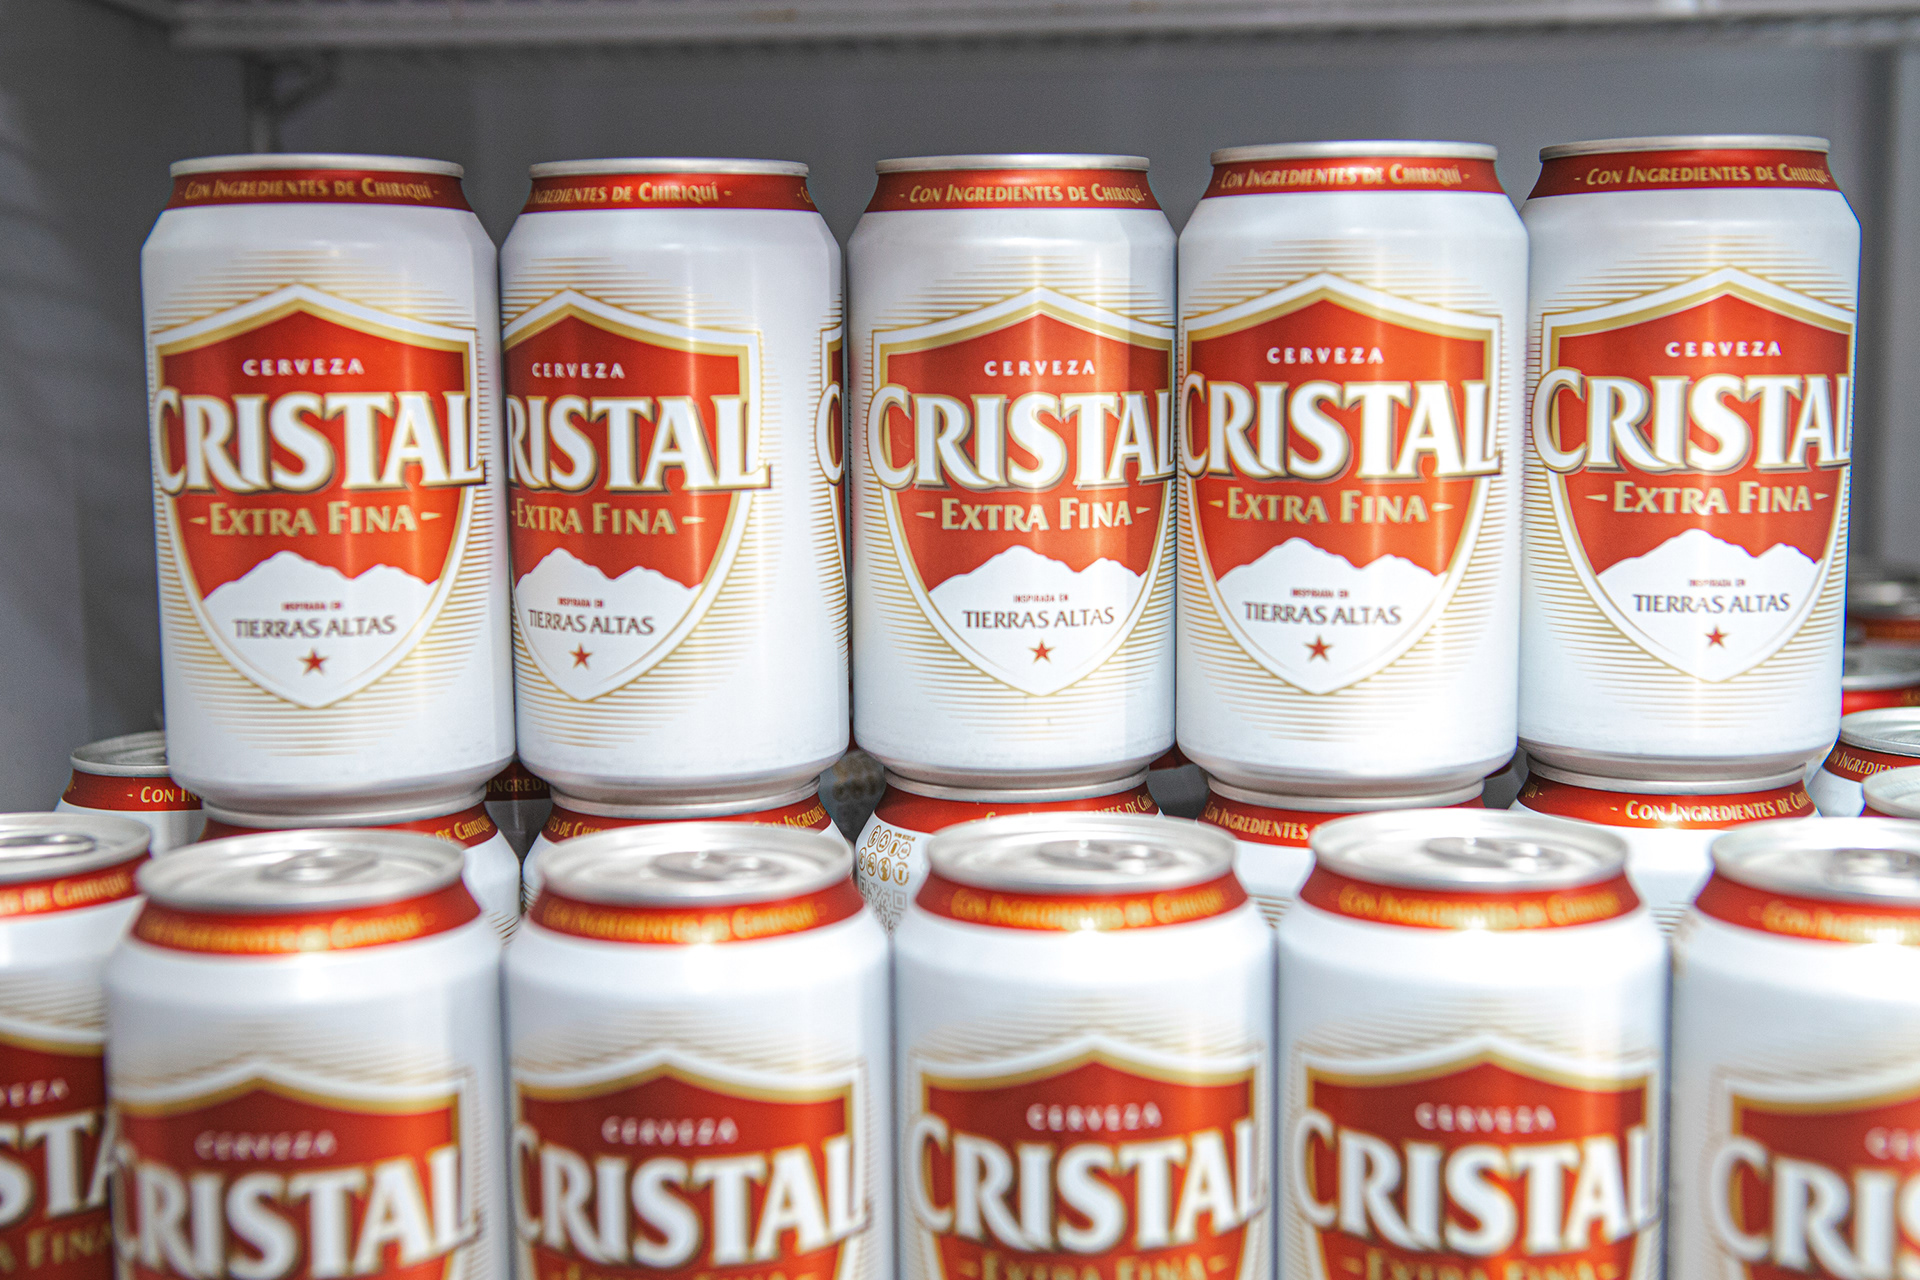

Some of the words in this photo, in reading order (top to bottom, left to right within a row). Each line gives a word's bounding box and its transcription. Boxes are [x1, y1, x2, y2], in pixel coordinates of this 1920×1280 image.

[1757, 166, 1776, 182] DE
[611, 185, 633, 203] DE
[1067, 185, 1089, 202] DE
[1266, 346, 1385, 365] CERVEZA
[1665, 340, 1783, 358] CERVEZA
[242, 358, 365, 377] CERVEZA
[531, 362, 626, 379] CERVEZA
[984, 359, 1096, 377] CERVEZA
[867, 383, 1176, 492] CRISTAL
[1180, 371, 1503, 482] CRISTAL
[154, 386, 486, 497] CRISTAL
[506, 394, 771, 494] RISTAL
[1227, 486, 1331, 524] EXTRA
[1340, 490, 1429, 524] FINA
[1613, 480, 1729, 516] EXTRA
[1738, 481, 1812, 513] FINA
[208, 502, 319, 537] EXTRA
[327, 500, 418, 535] FINA
[516, 498, 584, 535] EXTRA
[592, 502, 677, 535] FINA
[941, 498, 1050, 532] EXTRA
[1059, 498, 1133, 530] FINA
[1244, 601, 1327, 625] TIERRAS
[1331, 605, 1402, 625] ALTAS
[1633, 593, 1725, 614] TIERRAS
[1728, 592, 1791, 613] ALTAS
[233, 618, 321, 639] TIERRAS
[324, 615, 397, 637] ALTAS
[528, 609, 586, 633] TIERRAS
[590, 615, 655, 635] ALTAS
[962, 610, 1050, 629] TIERRAS
[1054, 606, 1115, 629] ALTAS
[140, 786, 174, 803] CON
[1625, 800, 1666, 821] CON
[1776, 798, 1792, 814] DE
[908, 1113, 1267, 1255] CRISTAL
[1293, 1108, 1660, 1256] CRISTAL
[513, 1122, 870, 1270] CRISTAL
